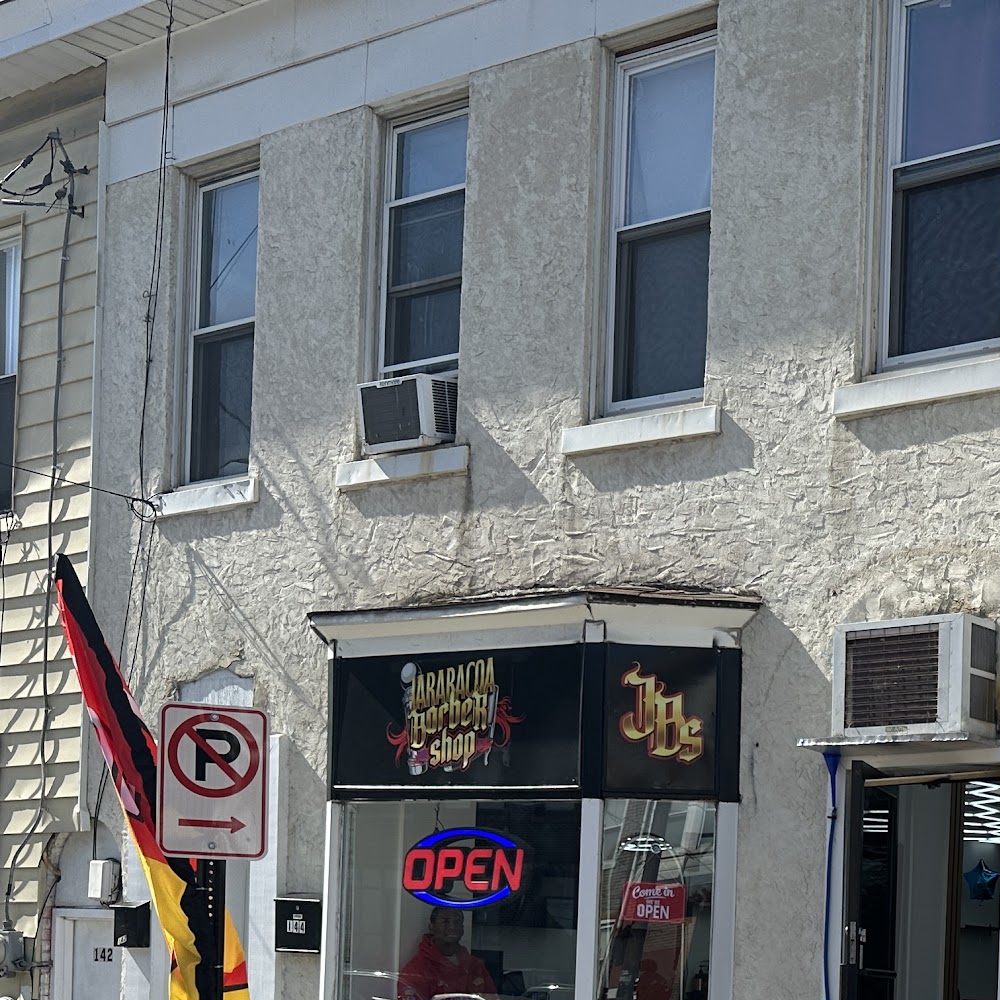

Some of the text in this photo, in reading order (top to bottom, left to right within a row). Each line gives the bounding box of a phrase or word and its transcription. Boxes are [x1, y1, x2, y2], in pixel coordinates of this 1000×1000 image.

[402, 848, 525, 891] OPEN
[632, 886, 675, 899] Come in
[636, 903, 670, 919] OPEN
[287, 920, 305, 934] 144
[94, 947, 113, 962] 142
